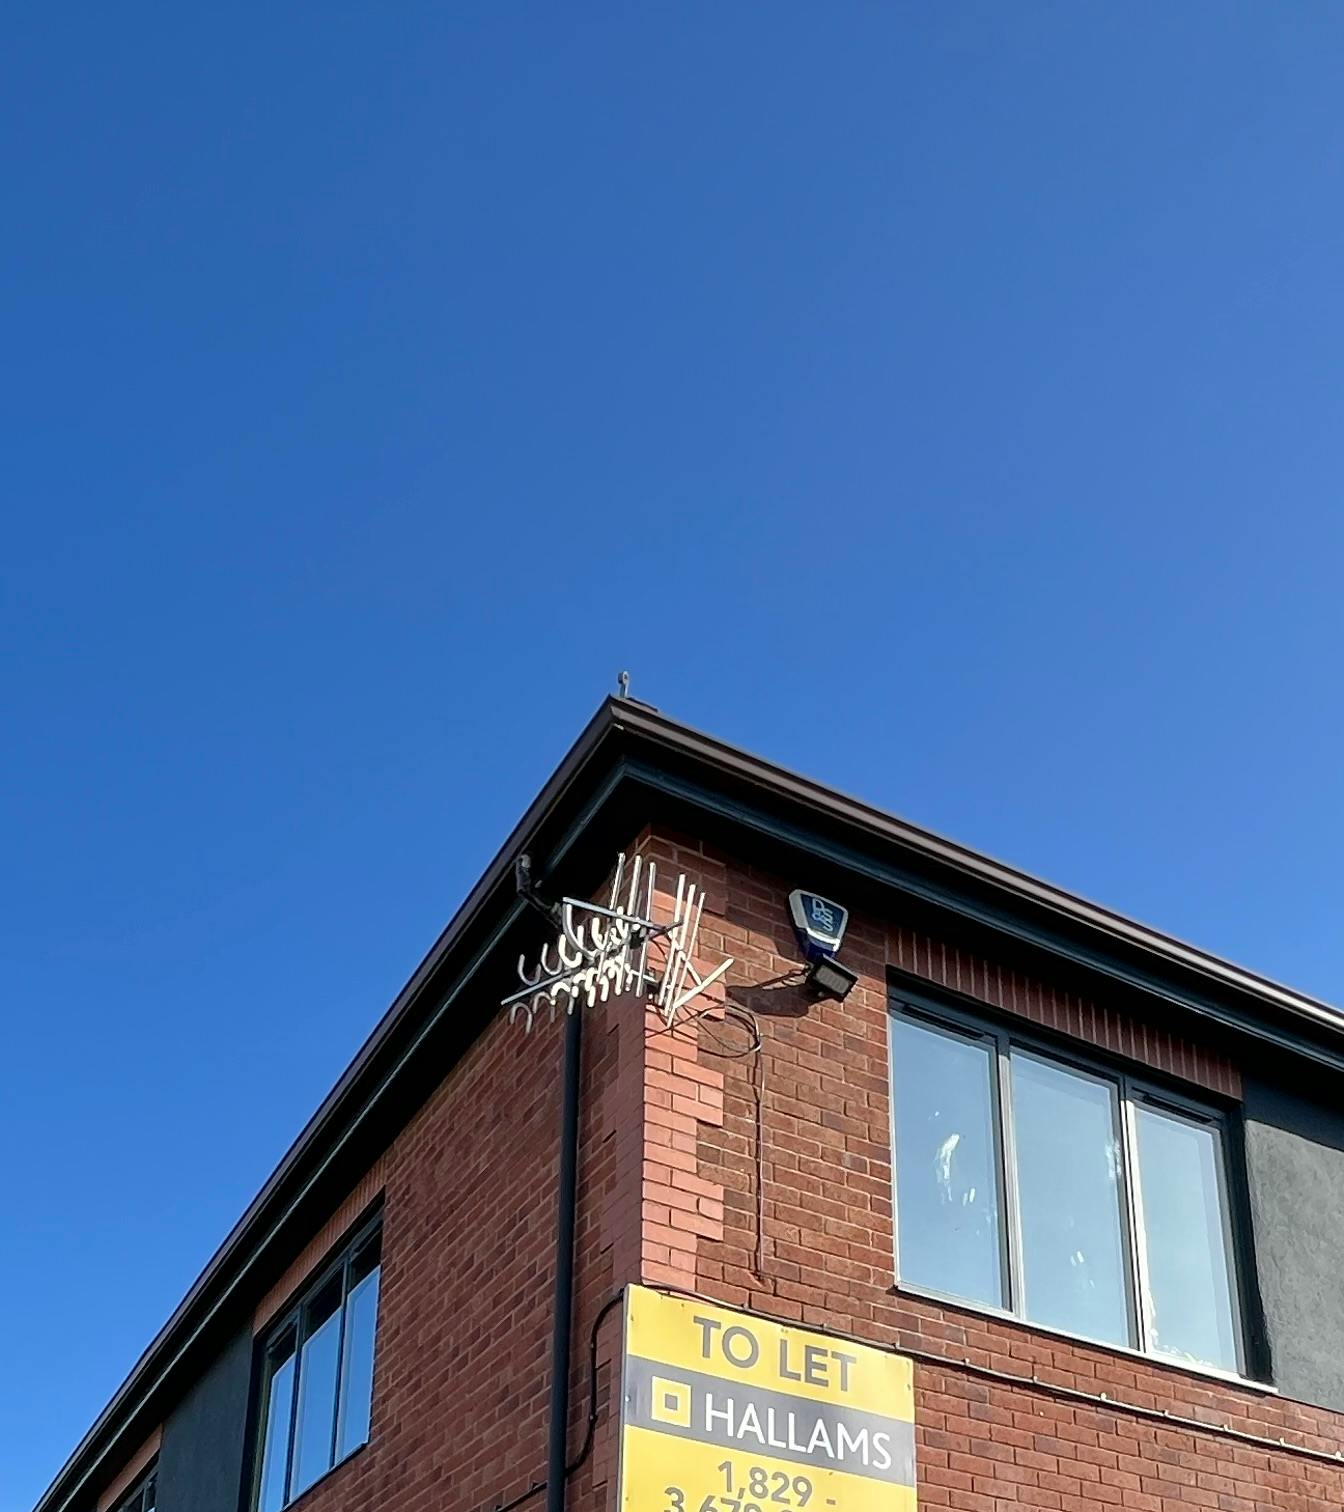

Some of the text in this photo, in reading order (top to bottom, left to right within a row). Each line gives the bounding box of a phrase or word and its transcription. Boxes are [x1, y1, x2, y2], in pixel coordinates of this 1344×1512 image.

[693, 1315, 857, 1392] TO LET
[704, 1392, 892, 1470] HALLAMS
[718, 1461, 813, 1507] 1,829
